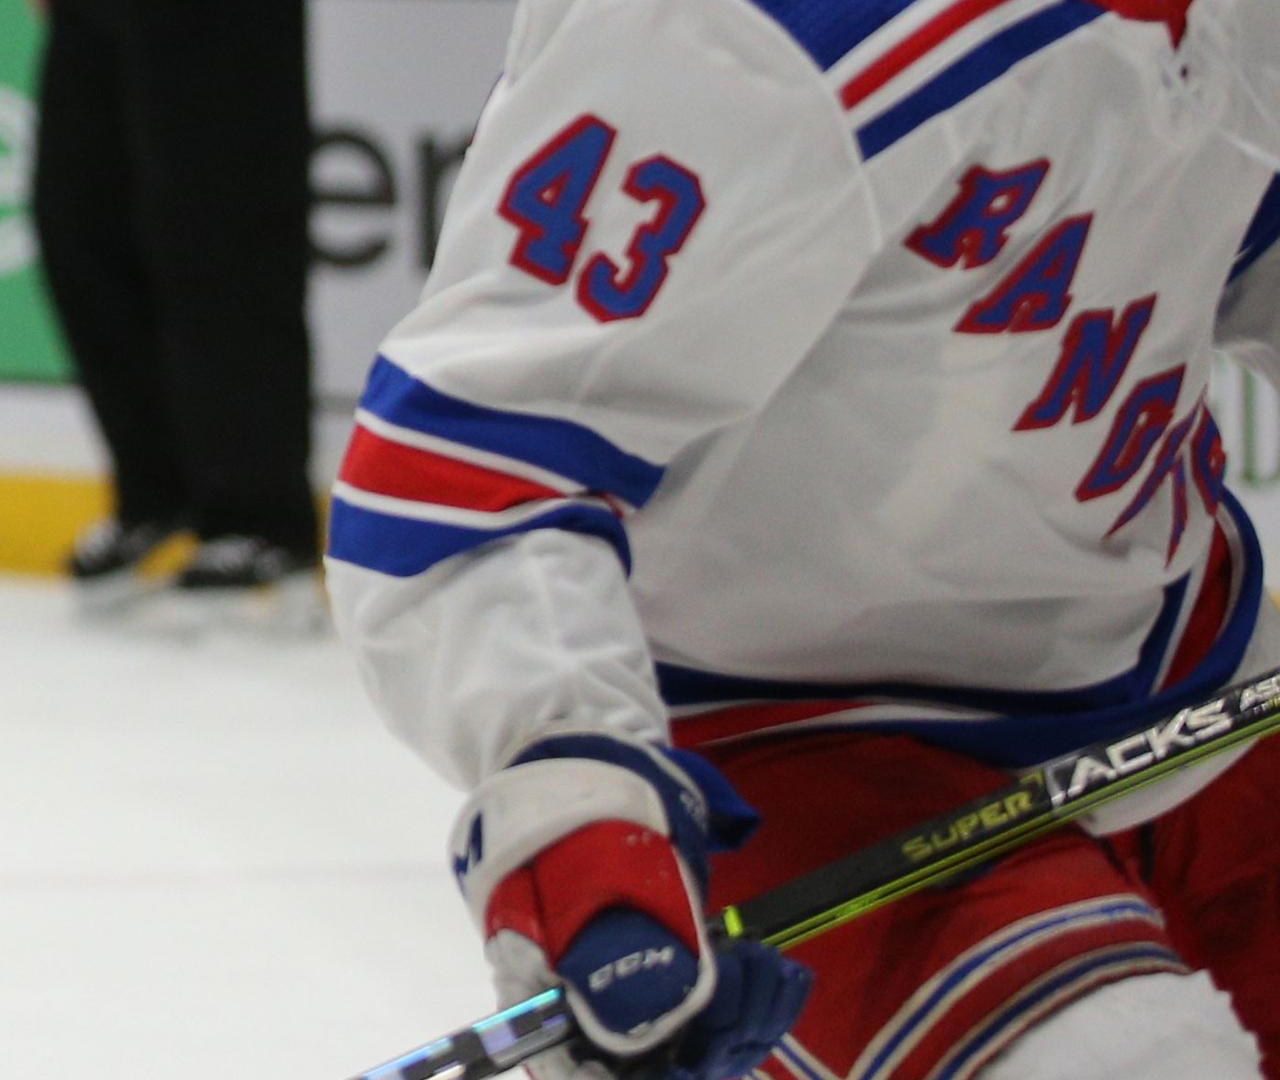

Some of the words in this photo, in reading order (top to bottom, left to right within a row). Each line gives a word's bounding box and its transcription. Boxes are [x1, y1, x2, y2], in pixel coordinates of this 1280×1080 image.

[497, 112, 707, 324] 43
[901, 789, 1034, 863] SUPER
[1042, 697, 1234, 808] TACKS
